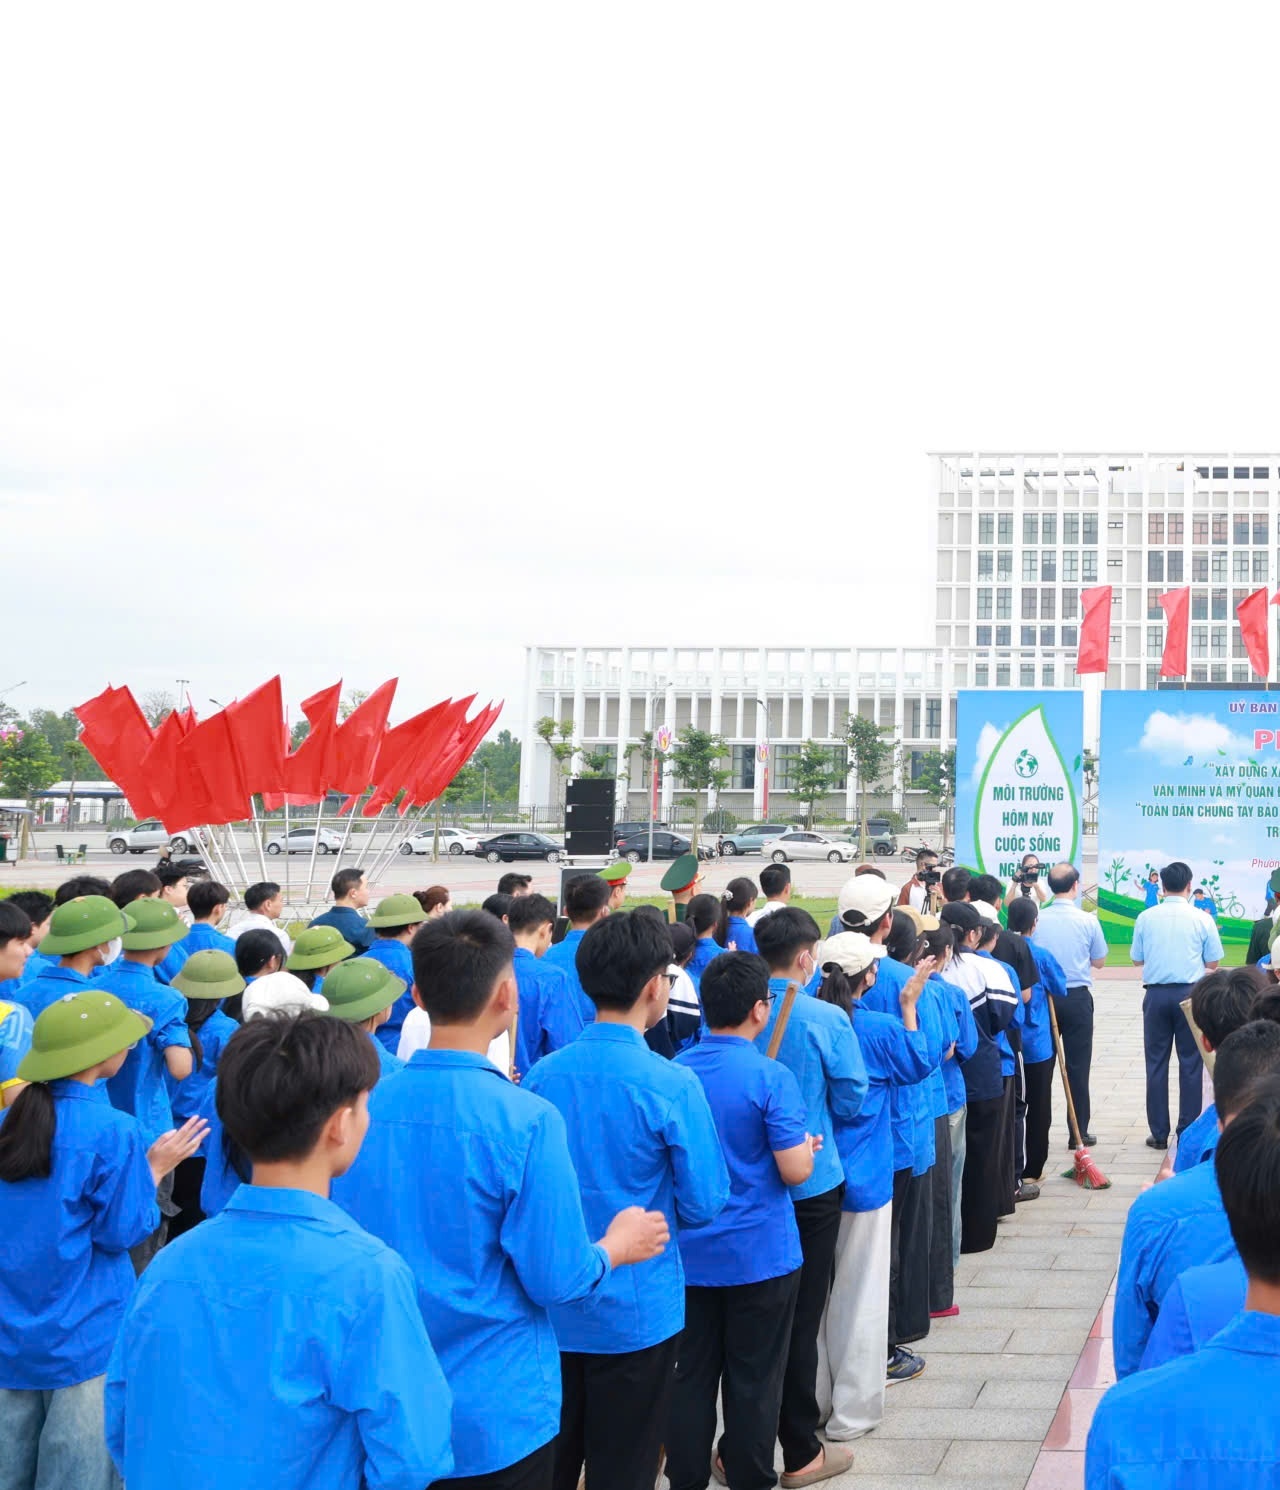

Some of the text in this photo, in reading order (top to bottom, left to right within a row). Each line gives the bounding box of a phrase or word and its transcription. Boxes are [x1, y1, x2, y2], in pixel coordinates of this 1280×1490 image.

[1250, 703, 1277, 713] BAN
[1239, 764, 1267, 779] DỰNG
[993, 782, 1064, 801] MÔI TRƯỜNG
[1153, 784, 1174, 797] VĂN
[1177, 785, 1206, 797] MINH
[1209, 783, 1223, 797] VÀ
[1246, 786, 1274, 798] QUAN
[1002, 808, 1054, 826] HÔM NAY
[1172, 803, 1194, 817] DÂN
[1197, 805, 1234, 817] CHUNG
[1237, 806, 1253, 817] TAY
[1257, 802, 1278, 818] BẢO
[994, 831, 1061, 855] CUỘC SỐNG
